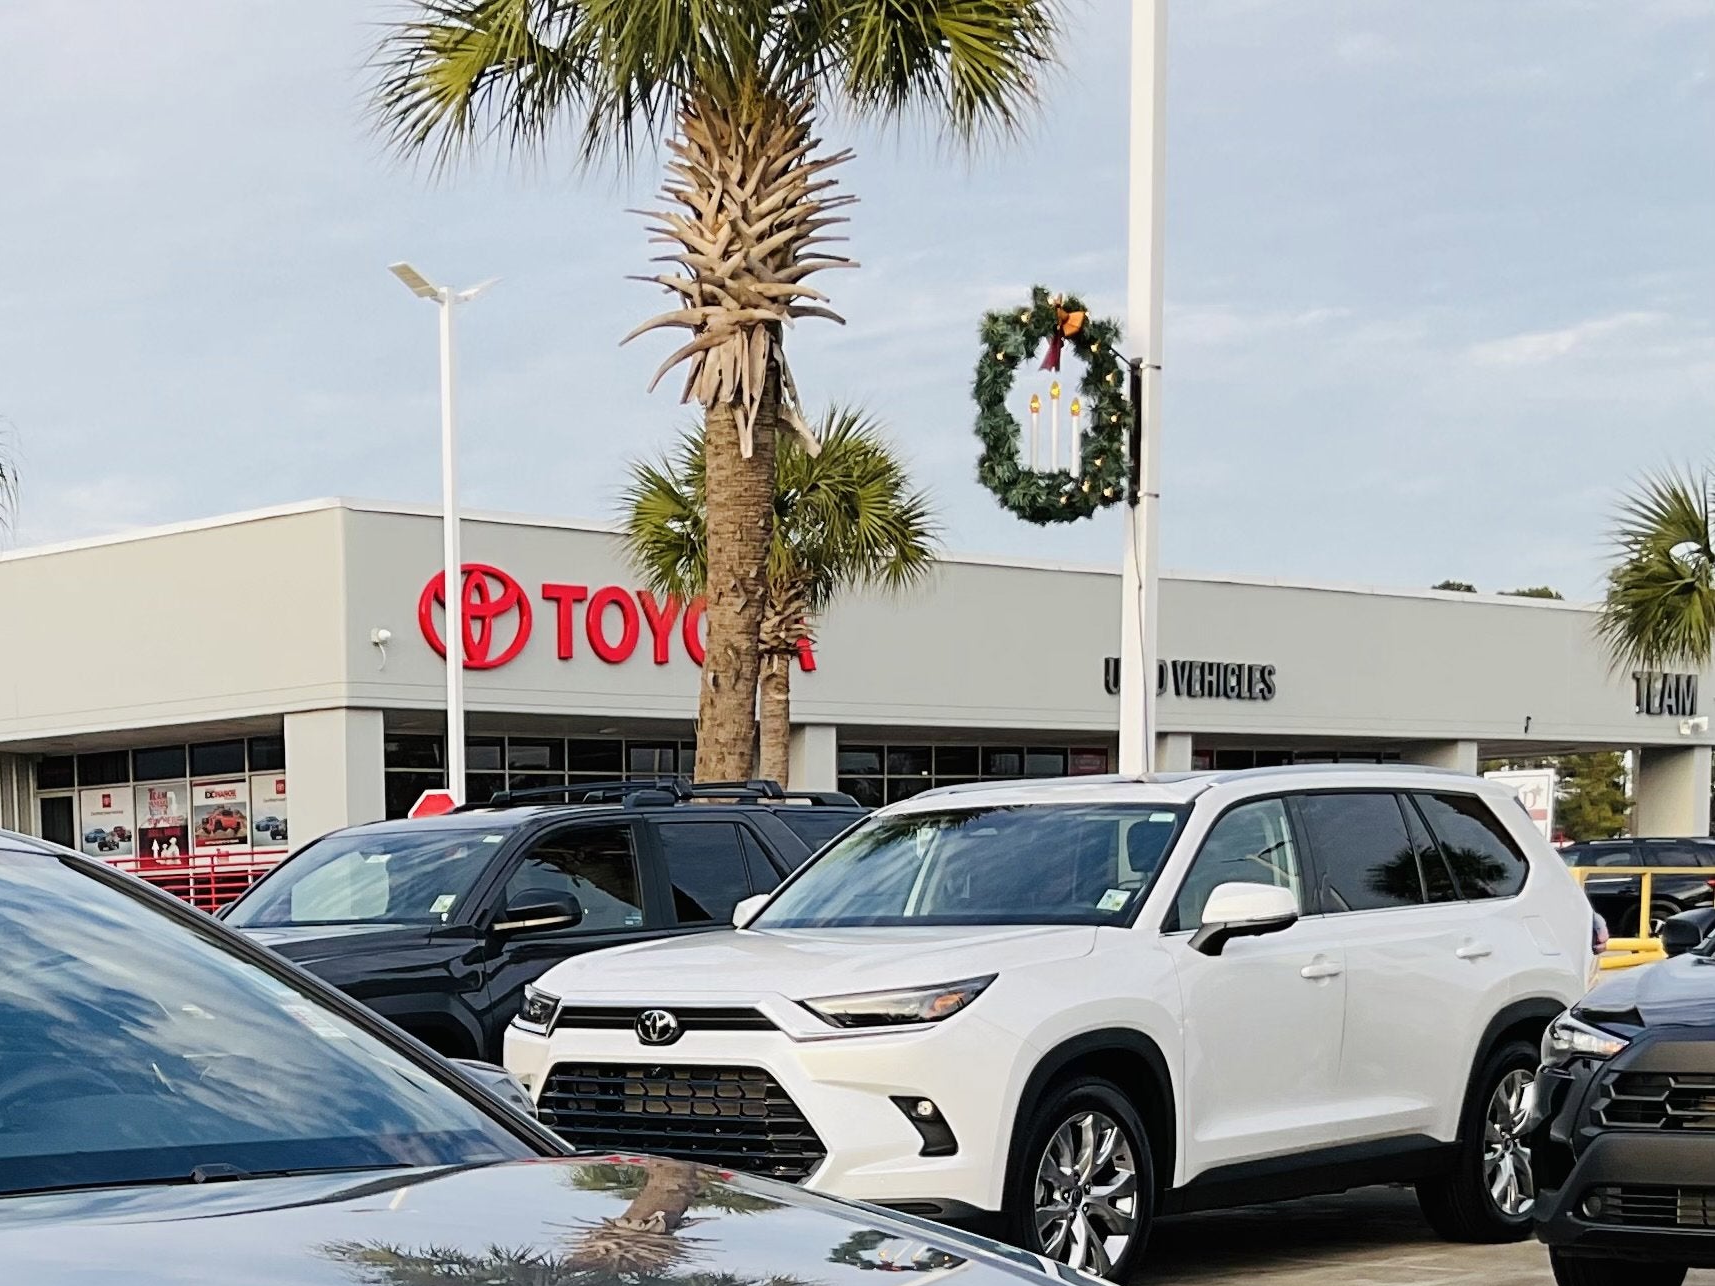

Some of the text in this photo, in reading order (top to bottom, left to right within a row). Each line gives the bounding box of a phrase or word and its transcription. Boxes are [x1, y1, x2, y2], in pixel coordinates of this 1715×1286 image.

[541, 582, 817, 672] TOY
[1103, 656, 1277, 702] UD VEHICLES
[1631, 671, 1699, 717] TEAM
